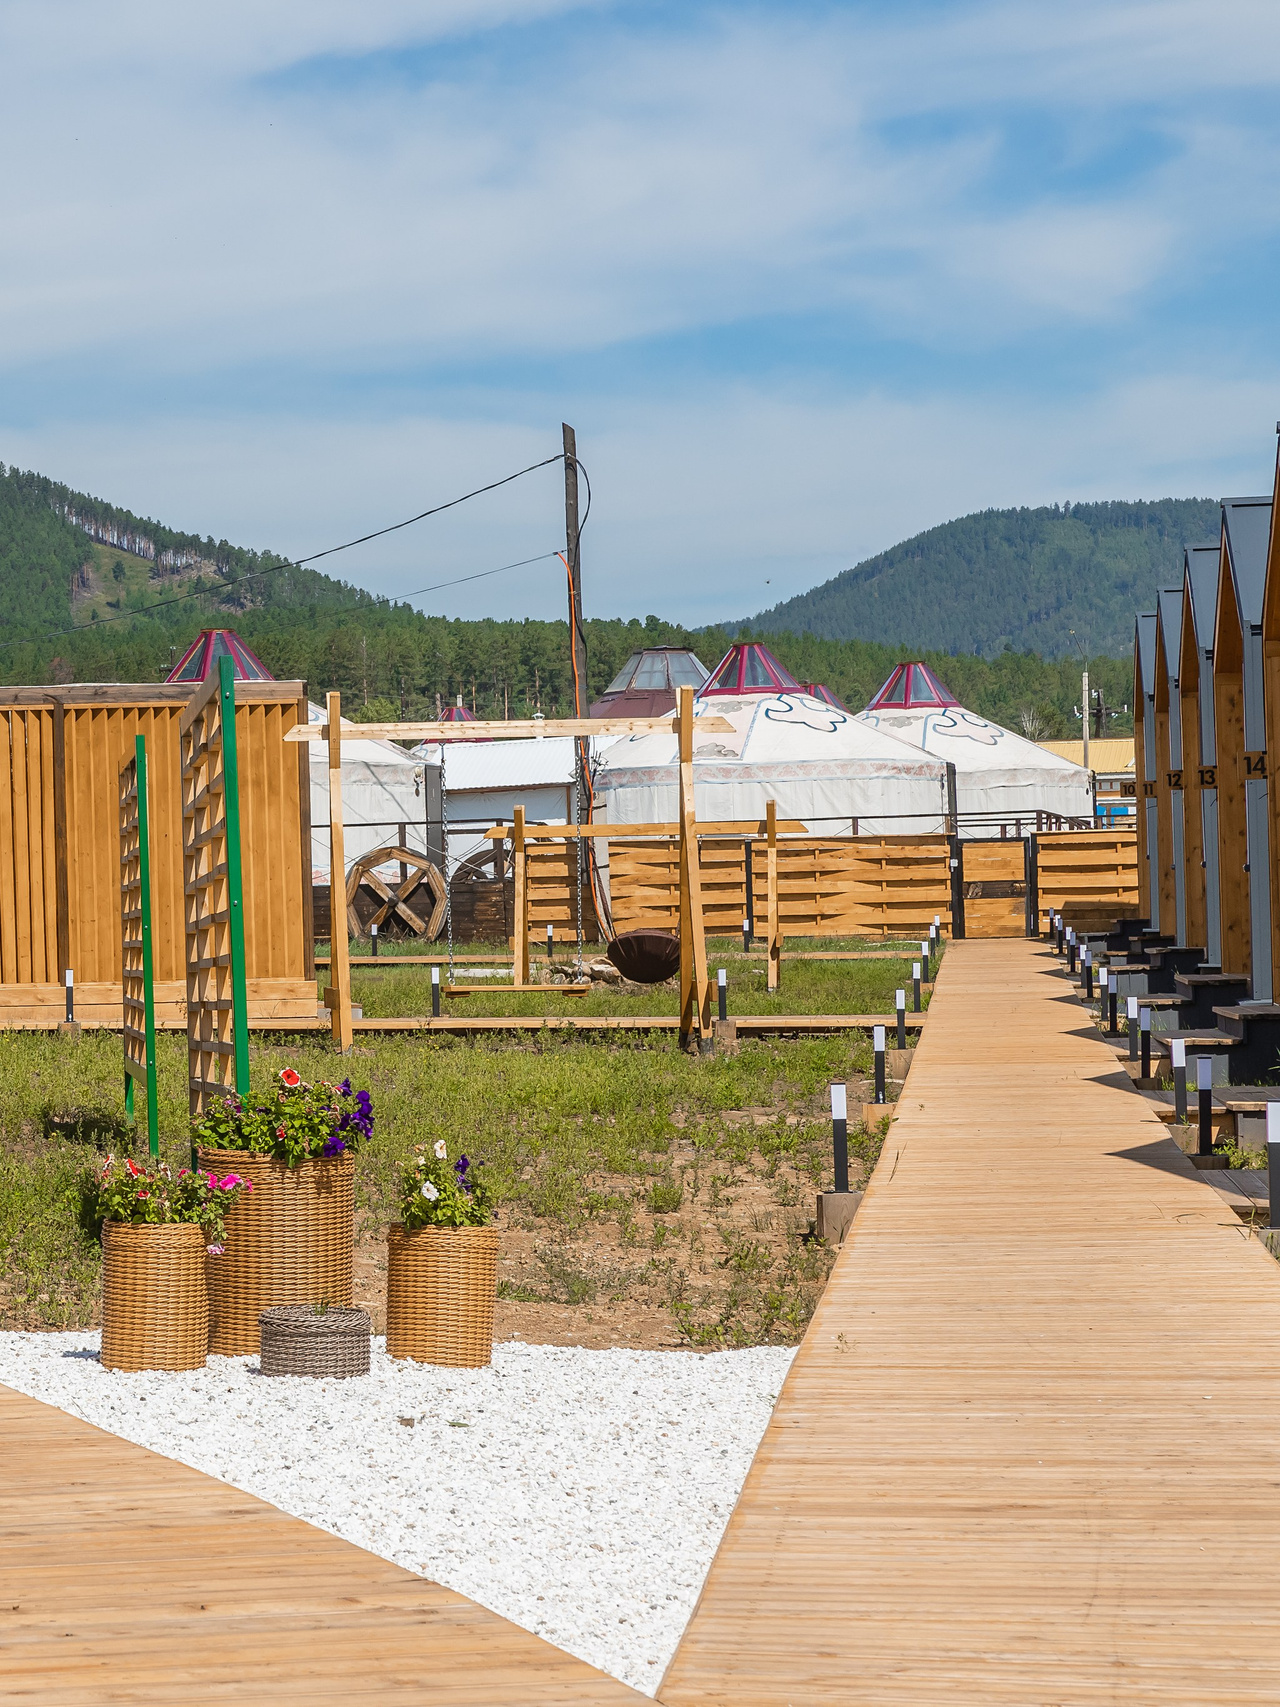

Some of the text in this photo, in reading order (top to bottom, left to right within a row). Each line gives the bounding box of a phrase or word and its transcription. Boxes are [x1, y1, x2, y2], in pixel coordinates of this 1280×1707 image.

[1243, 756, 1267, 775] 14
[1166, 773, 1182, 787] 12
[1197, 769, 1216, 785] 13
[1122, 784, 1136, 795] 10
[1143, 783, 1154, 796] 11
